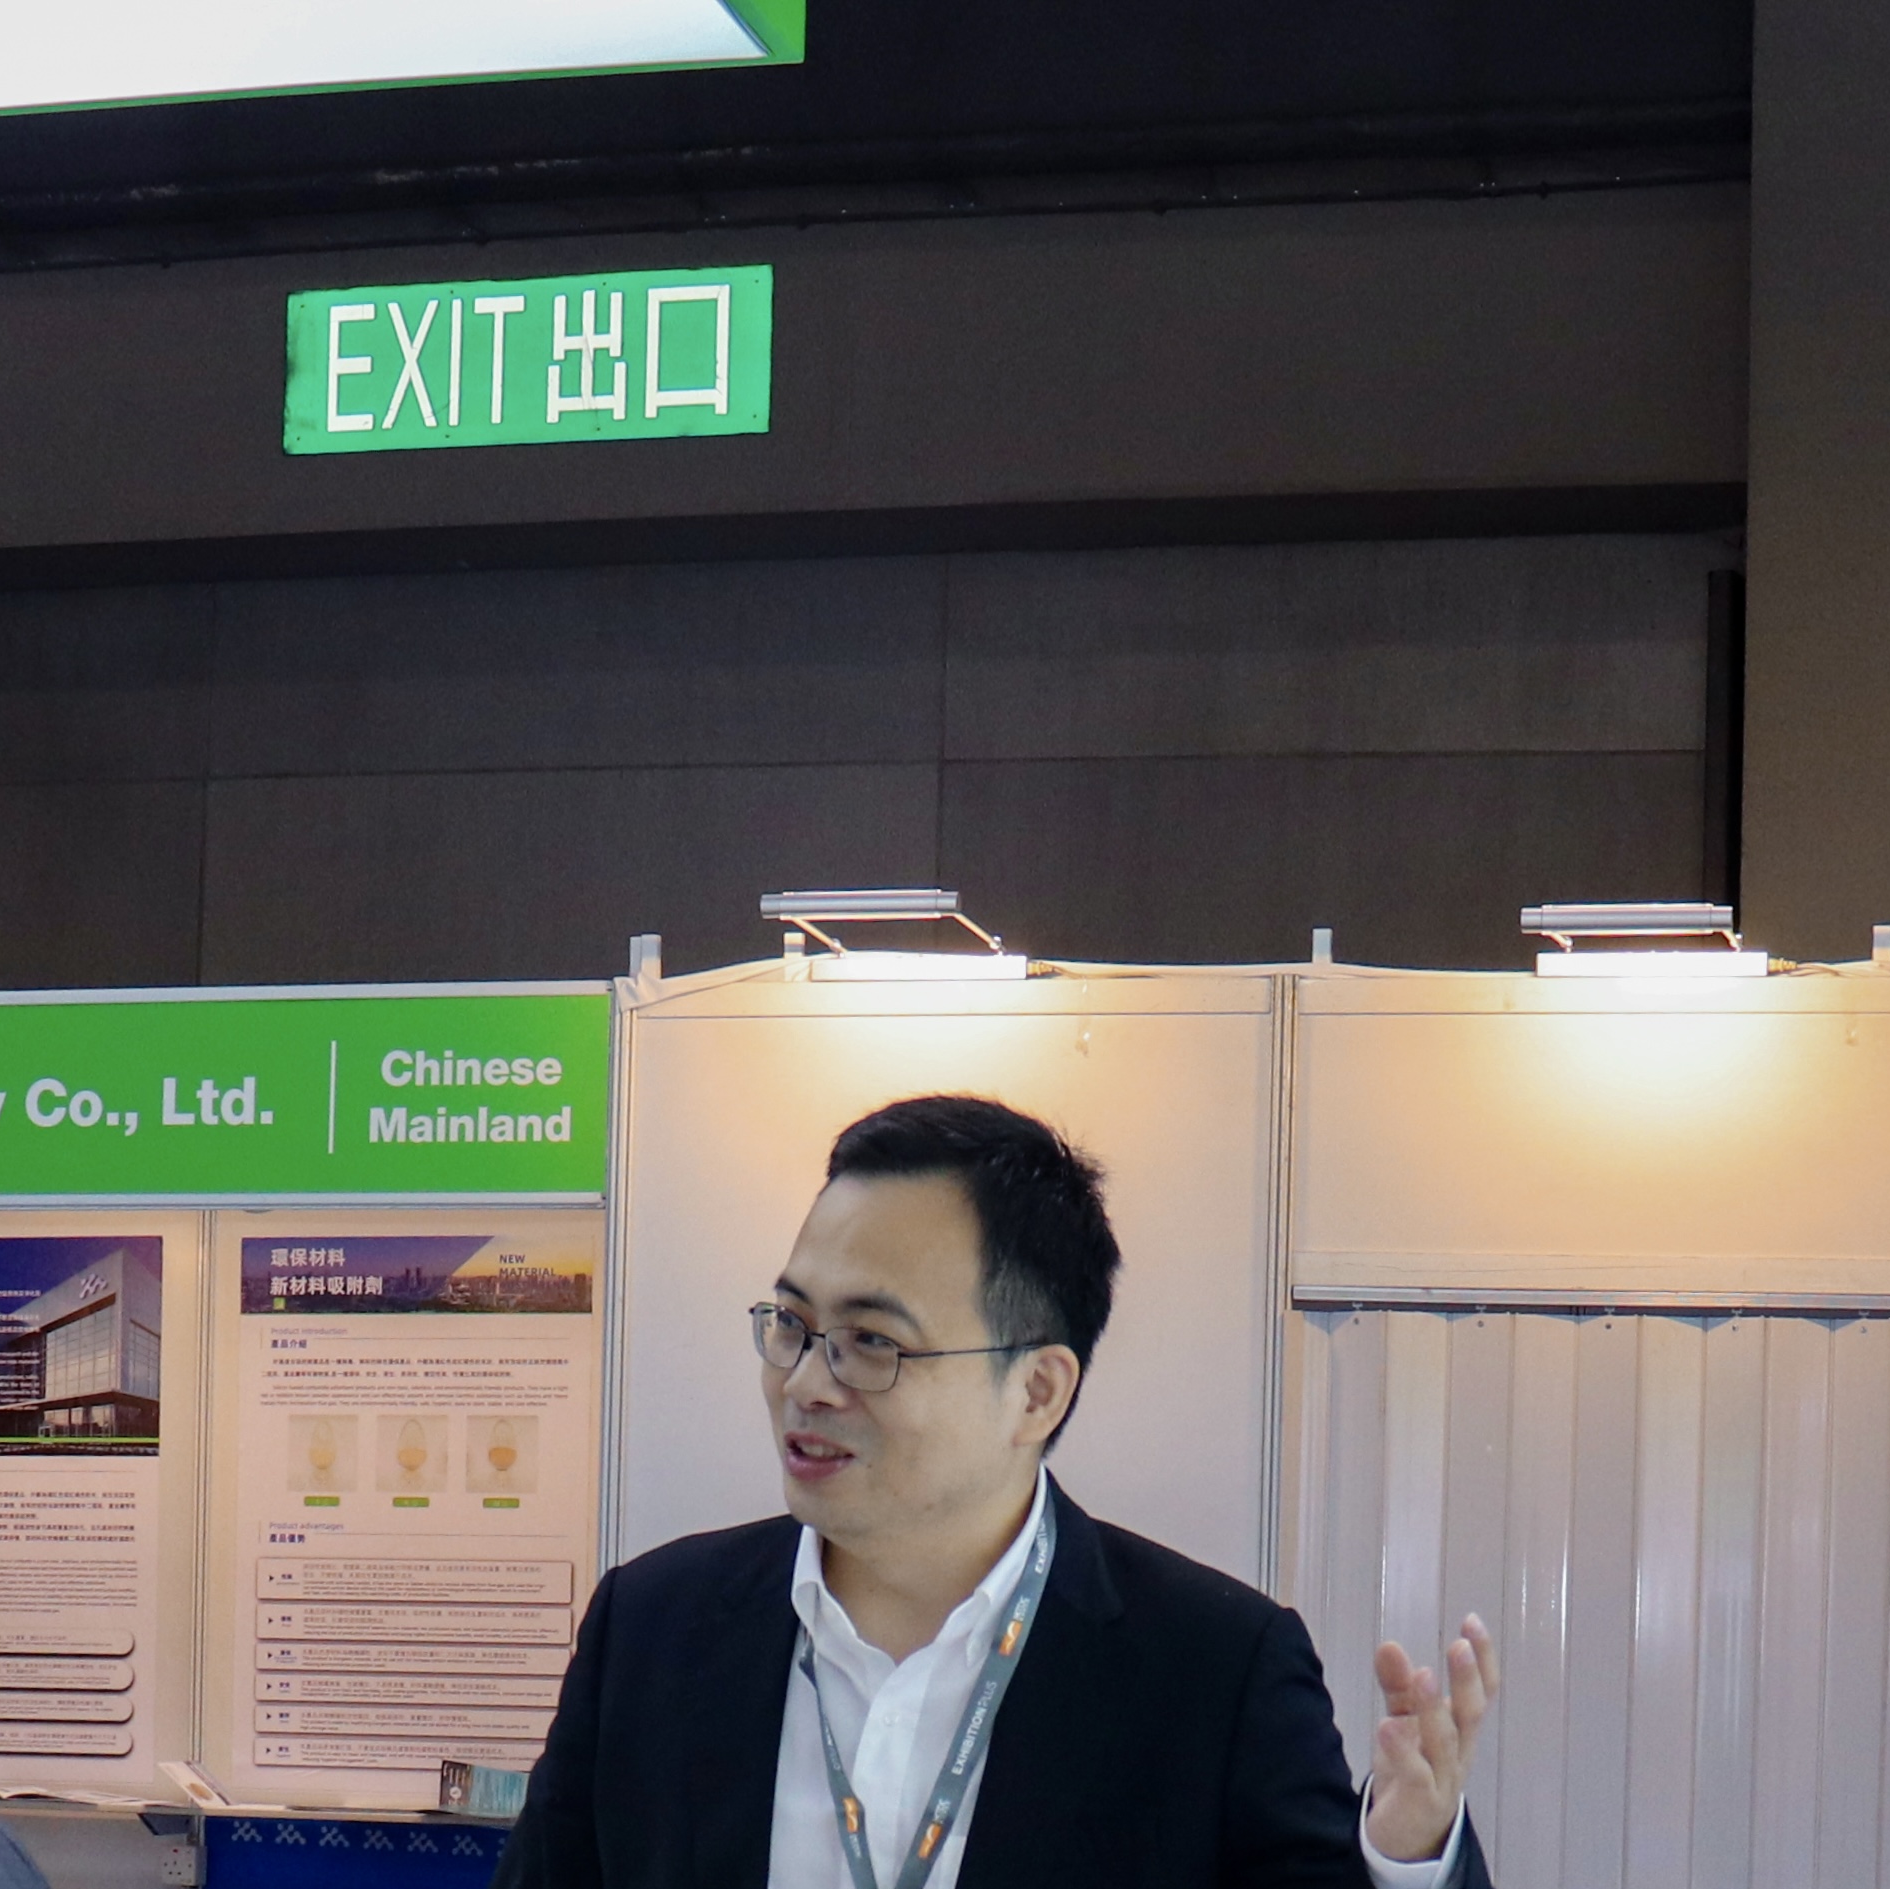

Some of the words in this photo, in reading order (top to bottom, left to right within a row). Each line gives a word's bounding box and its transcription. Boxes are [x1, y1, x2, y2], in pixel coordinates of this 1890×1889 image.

[327, 295, 525, 432] EXIT
[546, 284, 730, 424] 出口
[379, 1047, 564, 1088] Chinese
[23, 1073, 142, 1134] Co.,
[159, 1072, 274, 1128] Ltd.
[367, 1103, 572, 1145] Mainland
[271, 1248, 346, 1267] 環保材料
[499, 1254, 525, 1264] NEW
[499, 1267, 556, 1278] MATERIAL
[270, 1275, 383, 1295] 新材料吸附劑
